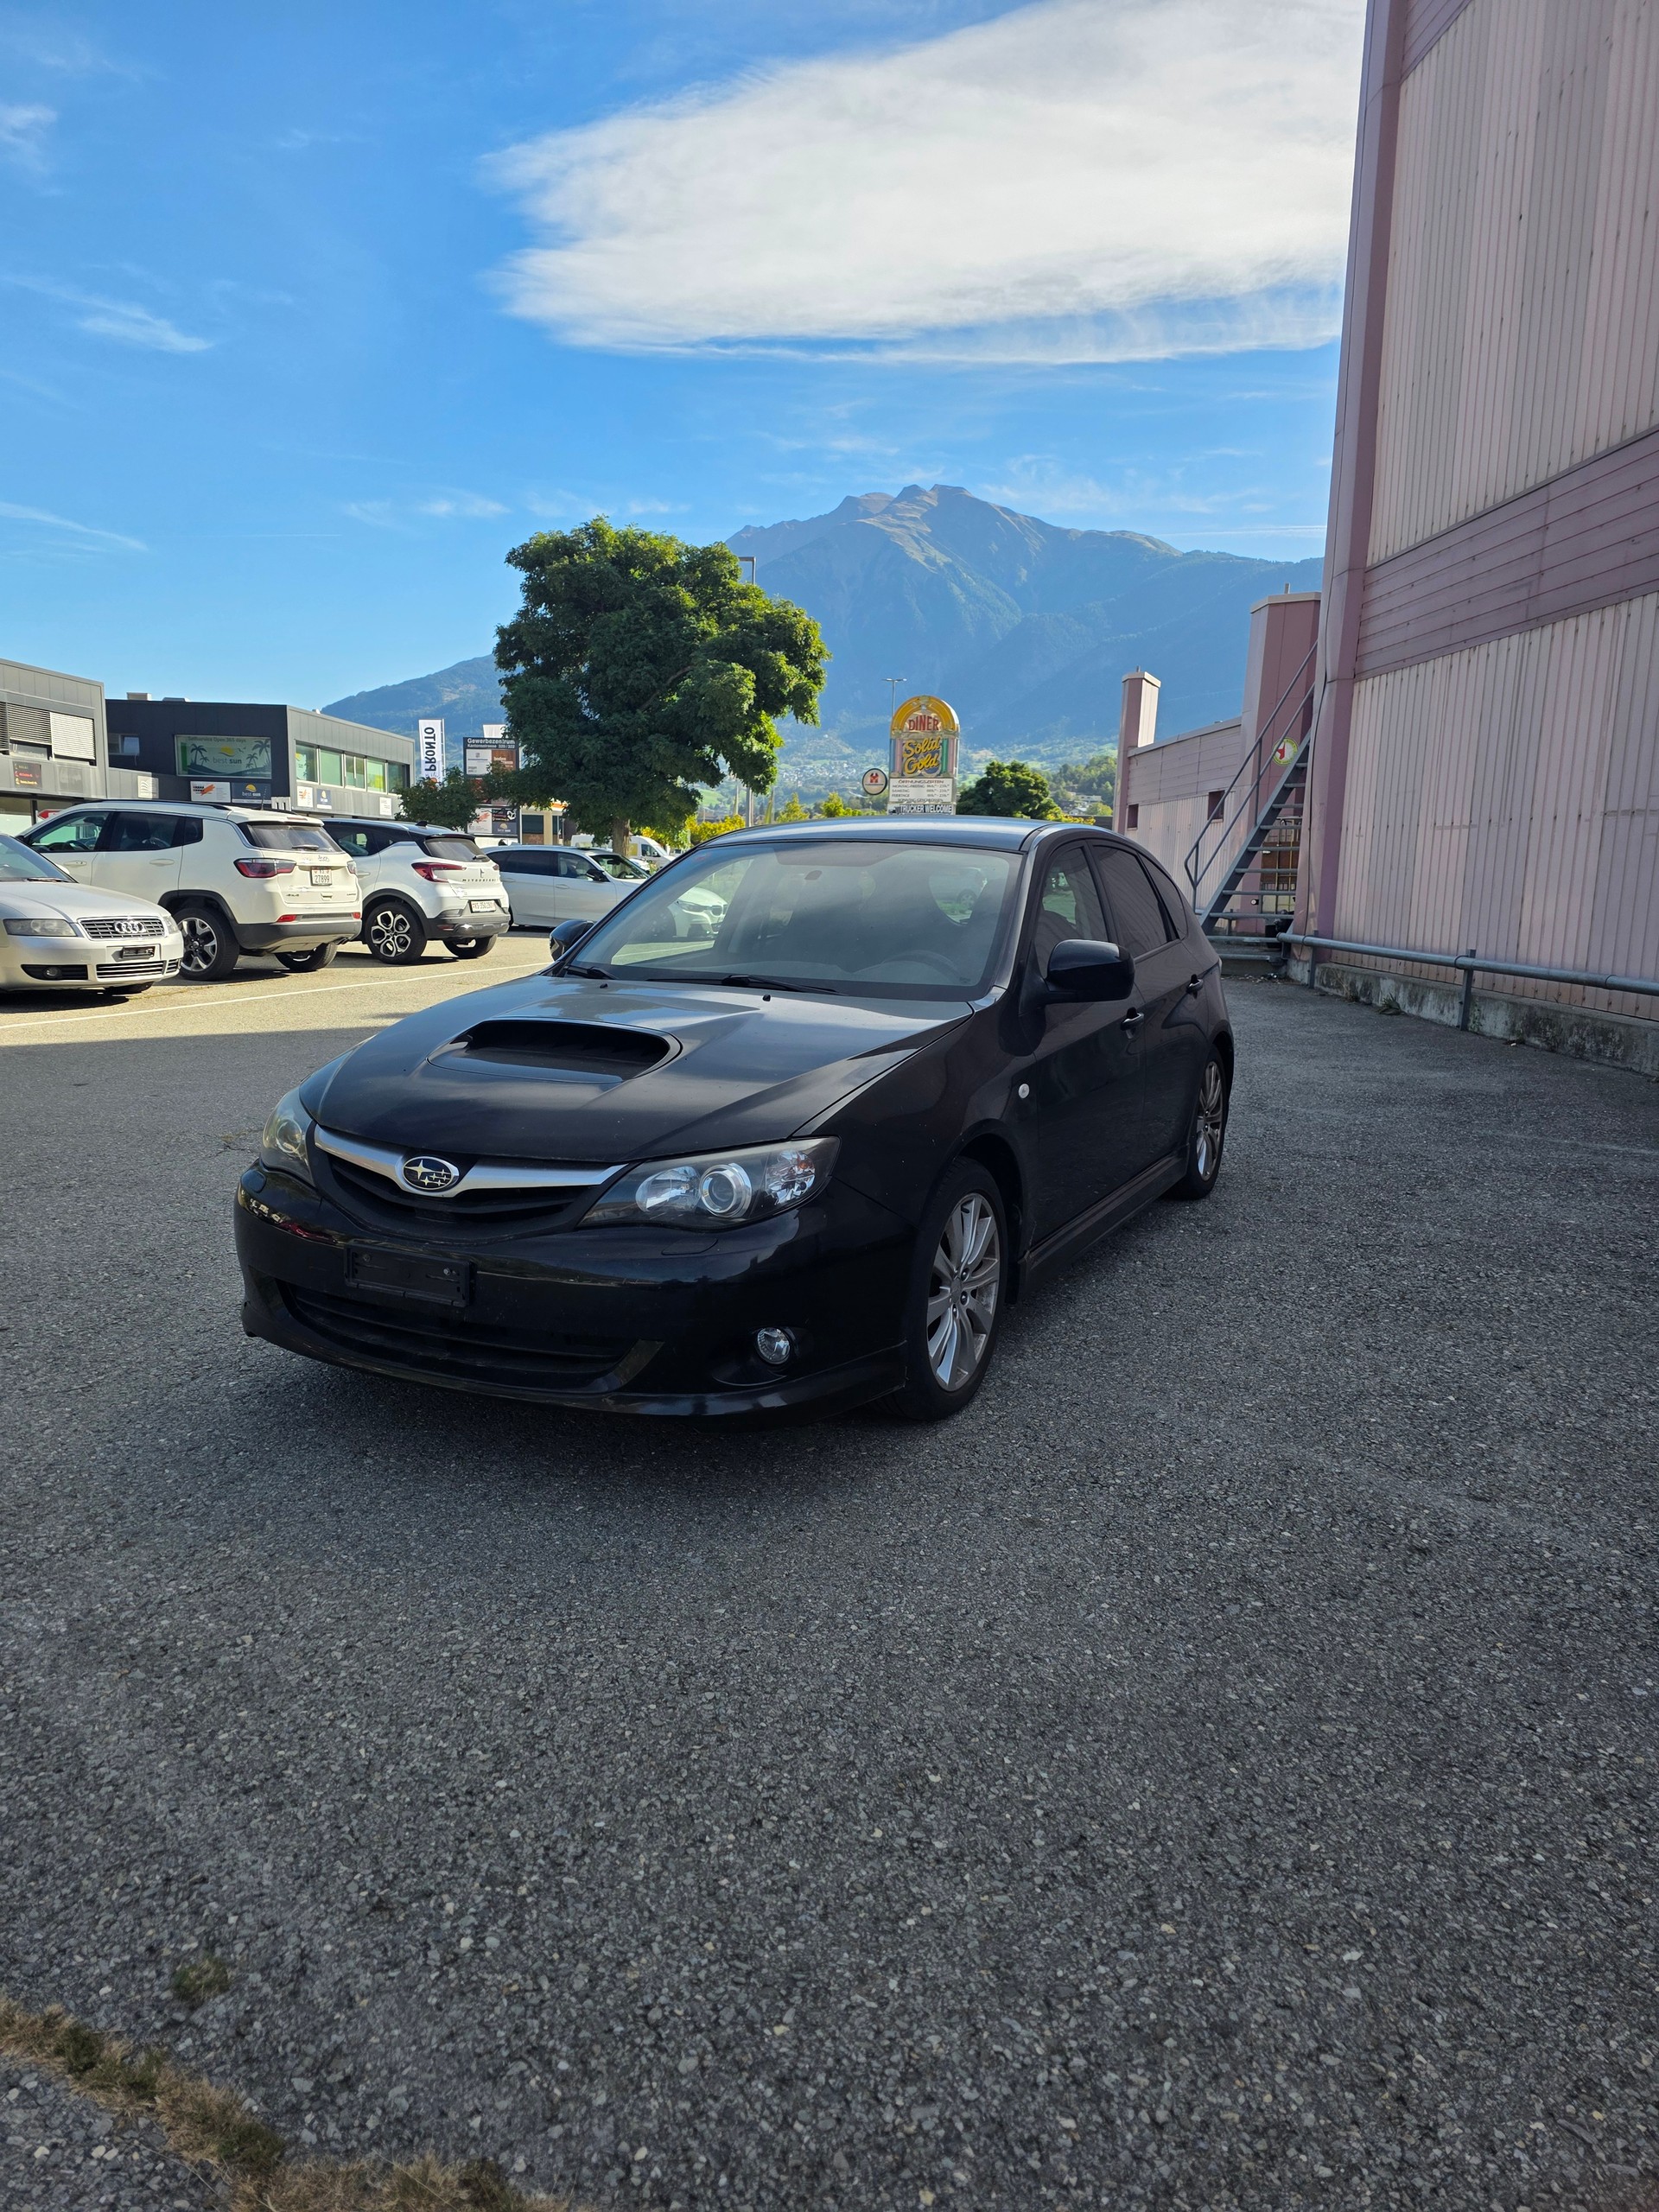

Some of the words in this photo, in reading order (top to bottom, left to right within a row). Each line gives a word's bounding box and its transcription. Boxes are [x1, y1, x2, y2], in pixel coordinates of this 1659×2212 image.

[908, 715, 939, 731] DINER
[902, 735, 941, 759] Solid
[904, 753, 939, 774] Gold
[900, 804, 925, 813] TRUCKER
[925, 804, 952, 813] WELCOME
